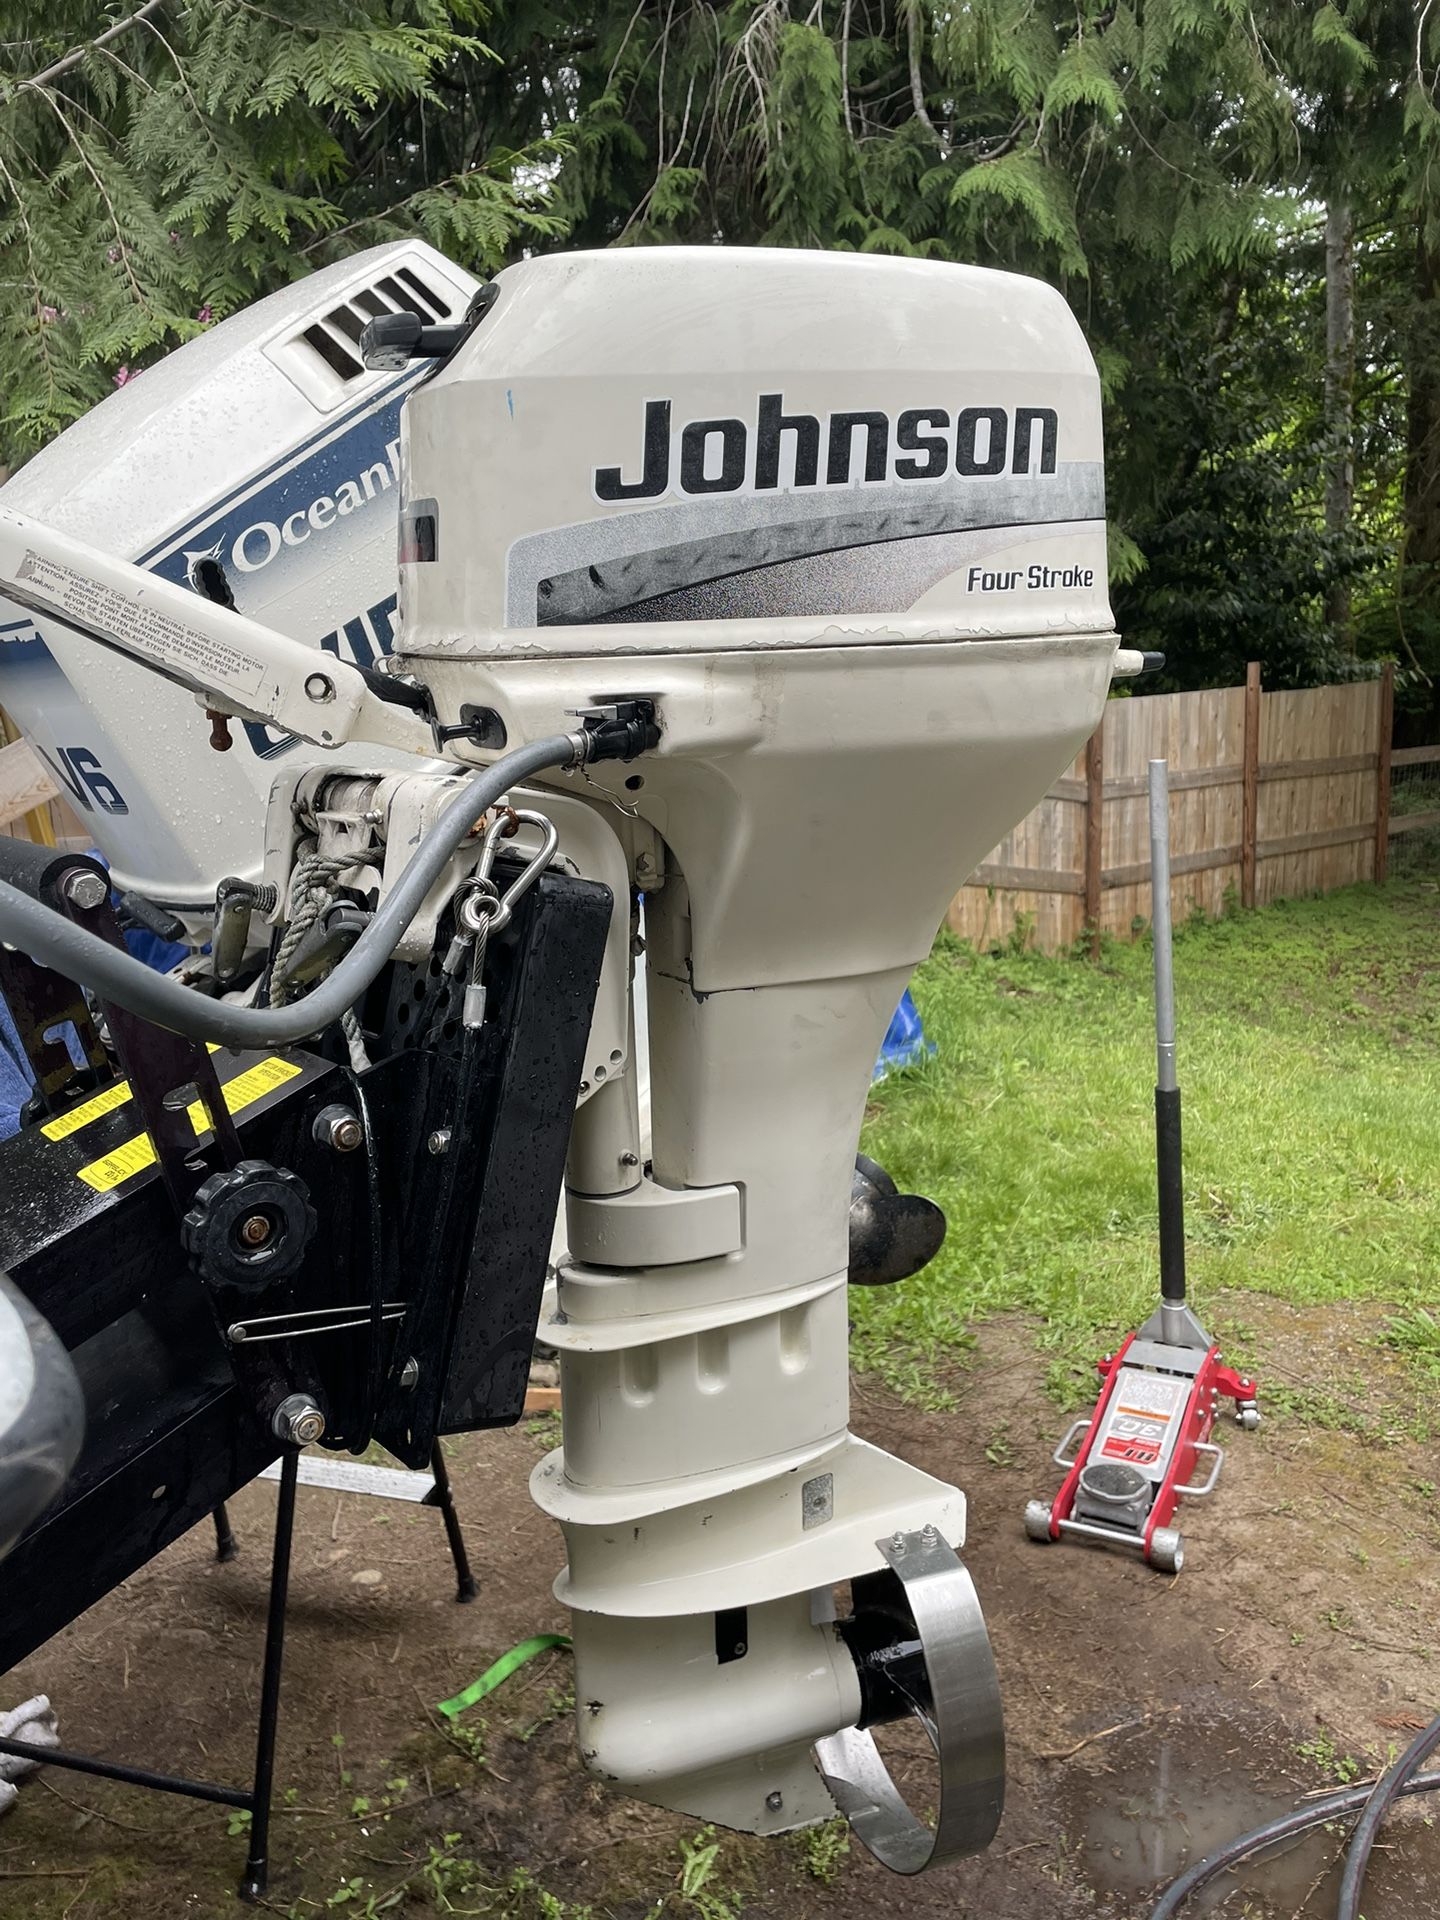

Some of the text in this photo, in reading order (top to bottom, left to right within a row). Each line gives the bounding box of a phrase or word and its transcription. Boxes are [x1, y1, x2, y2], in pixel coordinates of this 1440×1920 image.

[595, 393, 1058, 501] Johnson
[968, 565, 1093, 592] Four Stroke
[62, 592, 86, 607] BEVOR
[86, 604, 98, 613] SIE
[98, 609, 128, 627] STARTEN
[171, 645, 182, 654] SIE
[200, 659, 217, 671] DASS
[217, 668, 228, 676] DIE
[68, 587, 99, 605] POSITION
[100, 602, 119, 615] POINT
[119, 612, 138, 624] MORT
[139, 621, 160, 635] AVANT
[161, 632, 170, 640] DE
[122, 606, 136, 616] QUE
[148, 619, 184, 639] COMMANDE
[222, 655, 235, 664] EST
[241, 664, 250, 672] LA
[157, 615, 185, 632] NEUTRAL
[186, 629, 210, 644] BEFORE
[211, 641, 241, 659] STARTING
[36, 745, 129, 815] V6
